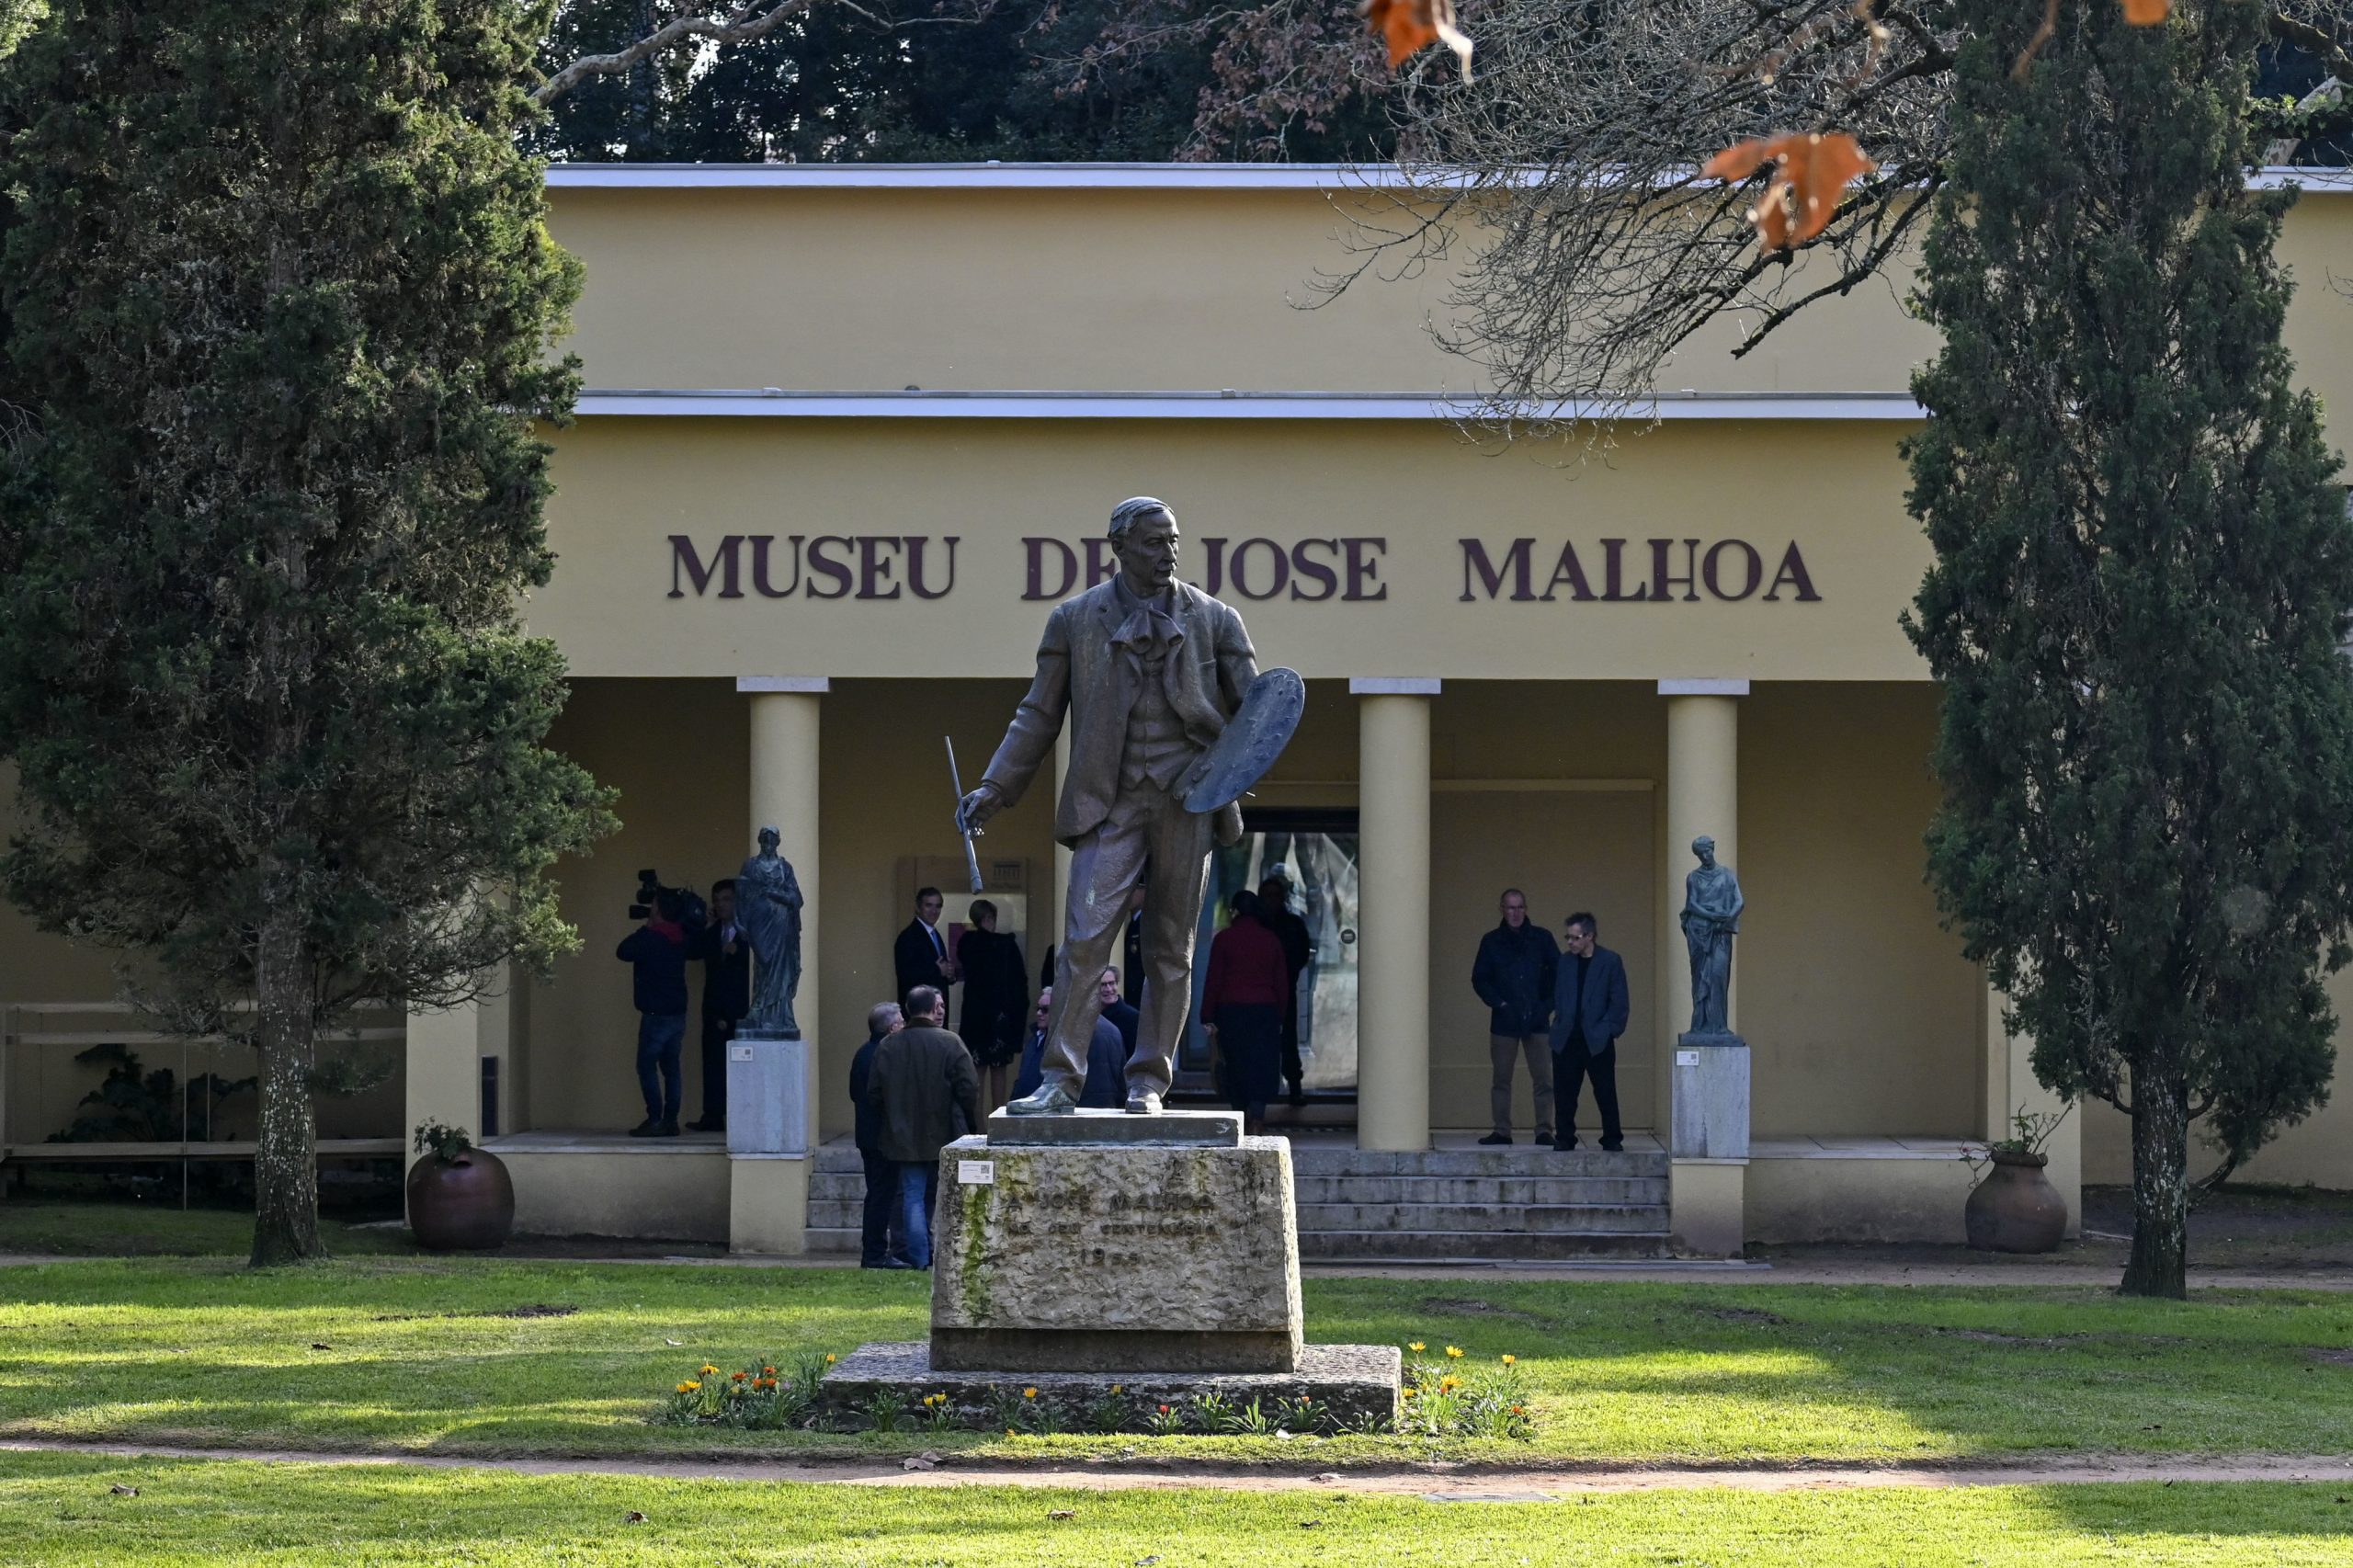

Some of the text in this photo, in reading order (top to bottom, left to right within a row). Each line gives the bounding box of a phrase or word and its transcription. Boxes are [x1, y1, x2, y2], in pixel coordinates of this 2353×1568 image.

[667, 535, 1823, 602] MUSEU DE JOSE MALHOA
[1109, 1192, 1215, 1212] MALHOA
